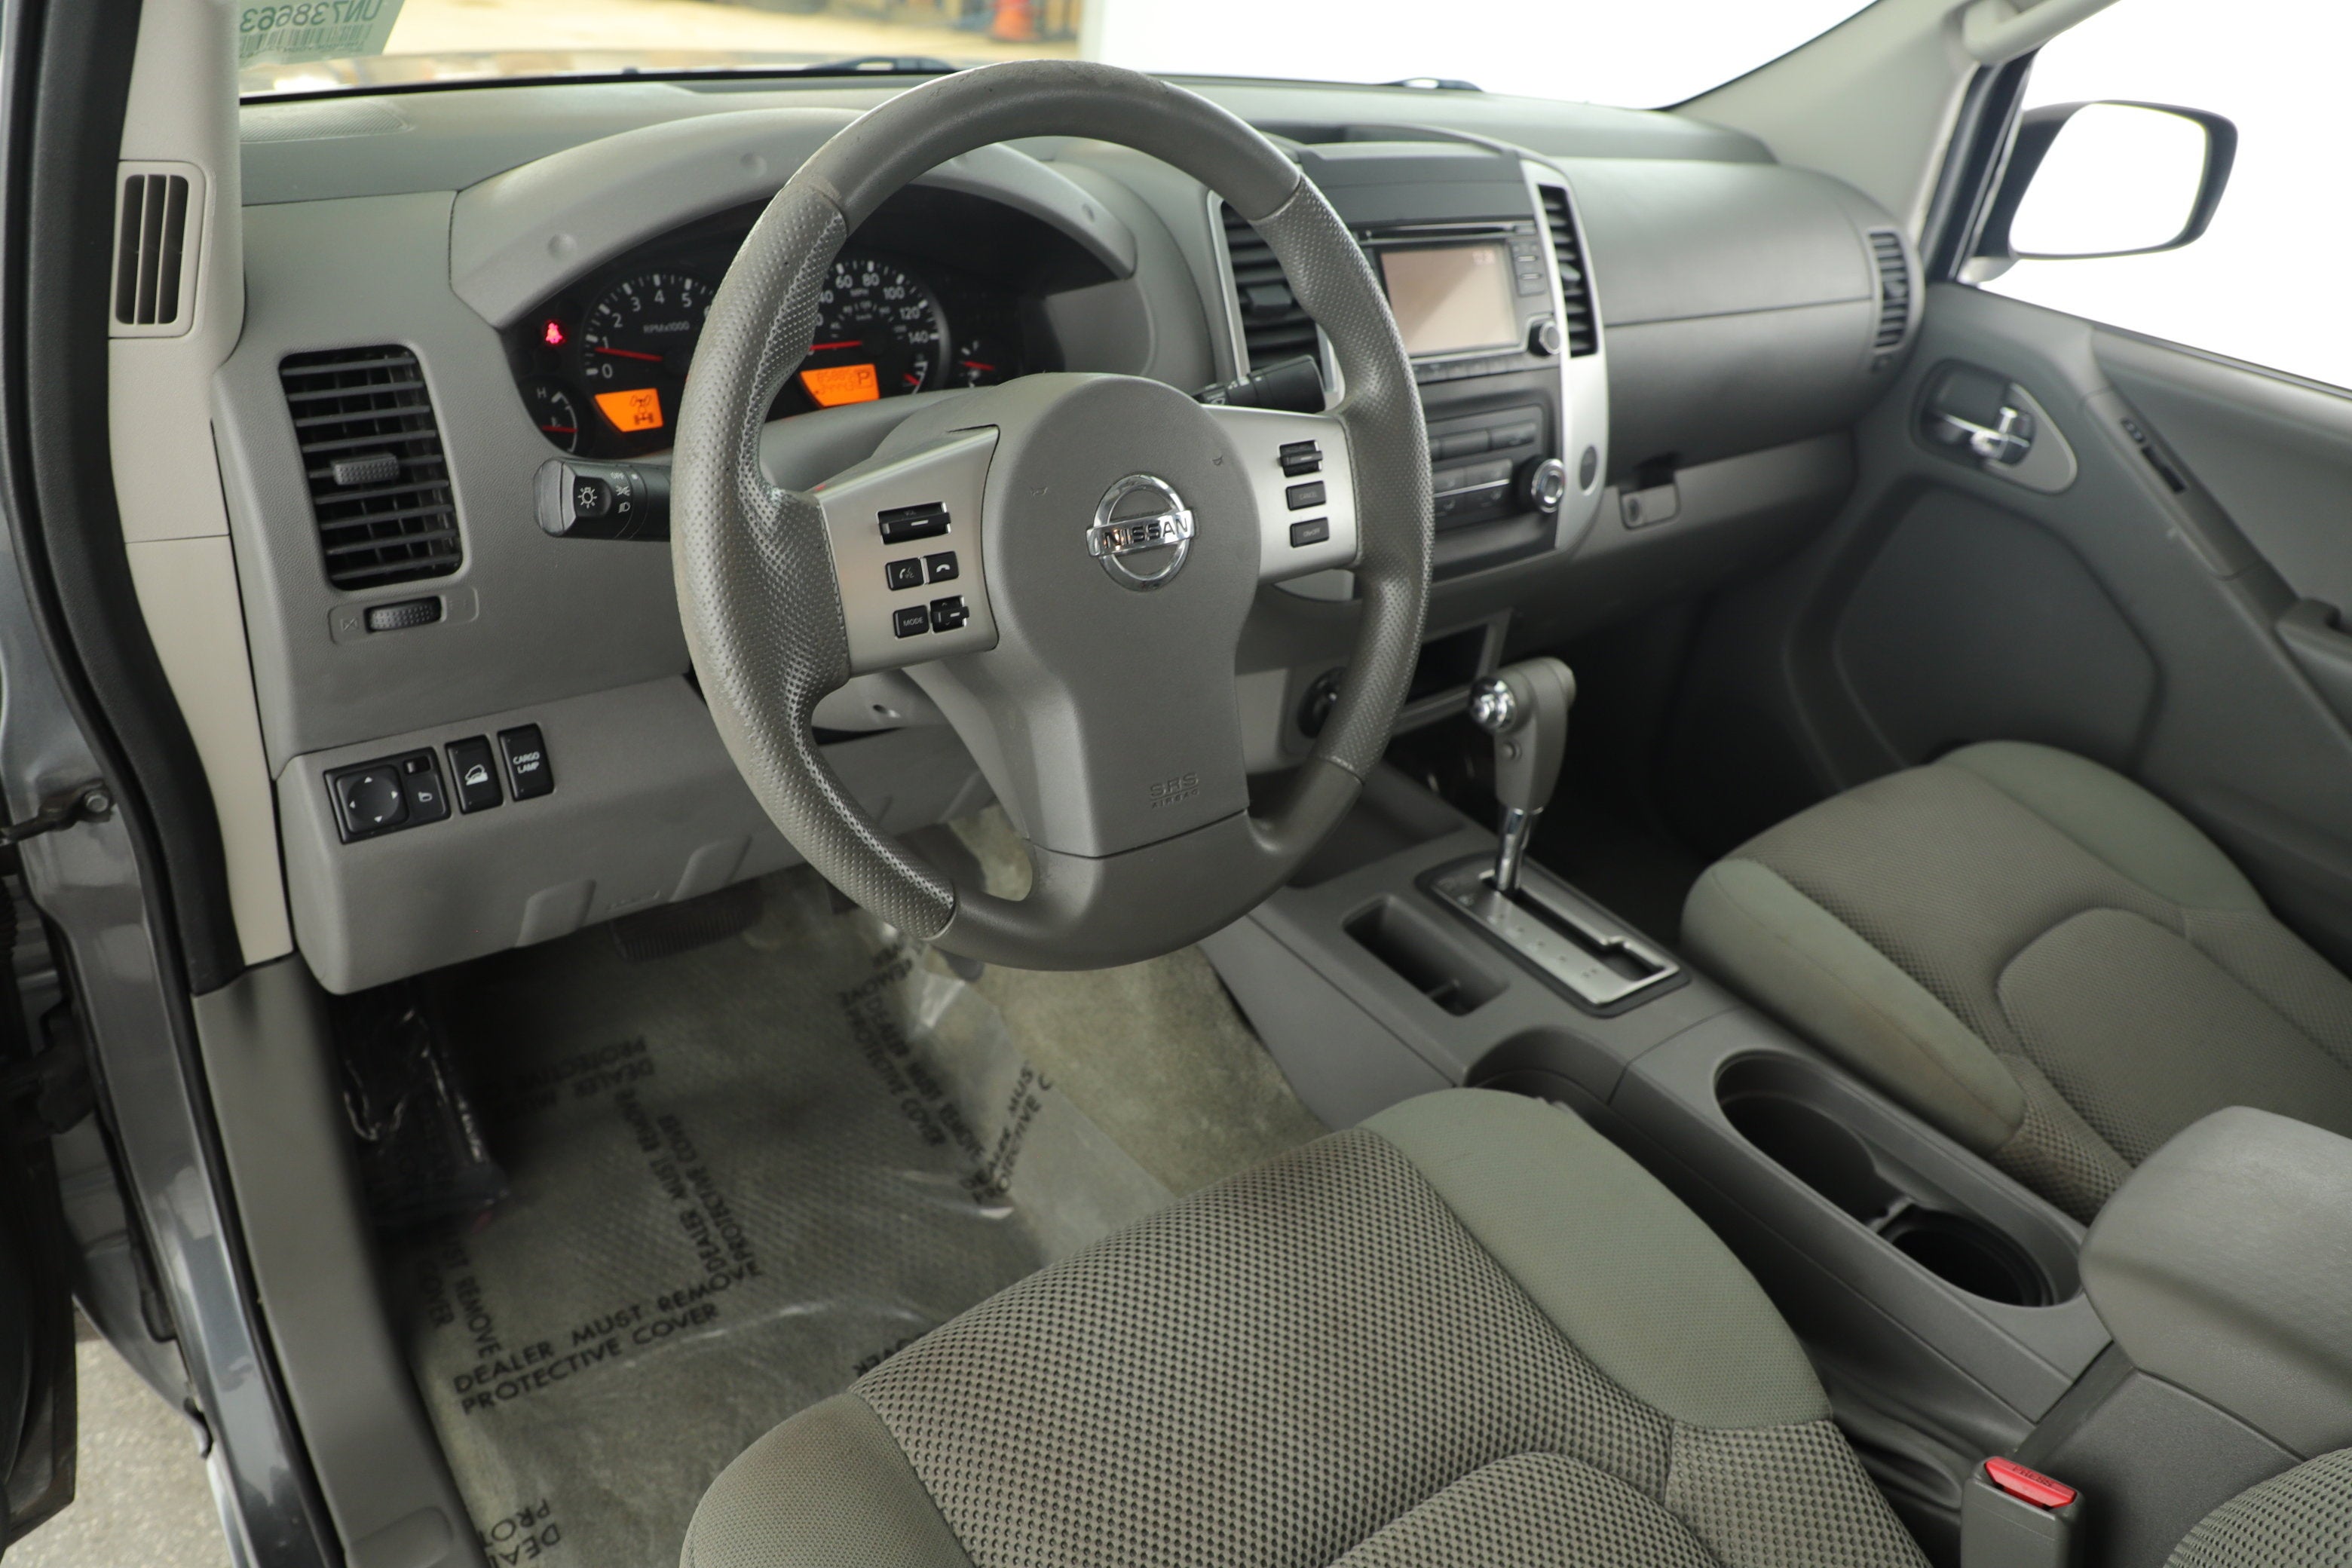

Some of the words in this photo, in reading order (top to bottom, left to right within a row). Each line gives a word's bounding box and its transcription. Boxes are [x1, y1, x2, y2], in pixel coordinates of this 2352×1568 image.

[835, 274, 853, 289] 60
[862, 272, 880, 287] 80
[654, 289, 665, 304] 4
[681, 292, 692, 308] 5
[883, 286, 905, 301] 100
[631, 297, 641, 311] 3
[612, 313, 623, 328] 2
[602, 363, 613, 379] 0
[536, 386, 547, 399] H
[1102, 516, 1189, 549] NISSAN
[903, 616, 924, 627] MODE
[513, 751, 541, 765] CARGO
[517, 761, 540, 774] LAMP
[1150, 772, 1199, 798] SRS
[649, 1156, 688, 1201] MUST
[685, 1166, 755, 1263] PROTECTIVE
[680, 1209, 727, 1275] DEALER
[455, 1276, 502, 1359] REMOVE
[454, 1341, 554, 1395] DEALER
[571, 1305, 645, 1346] MUST
[657, 1260, 765, 1312] REMOVE
[462, 1337, 623, 1415] PROTECTIVE
[632, 1303, 718, 1345] COVER
[2012, 1465, 2053, 1488] PRESS
